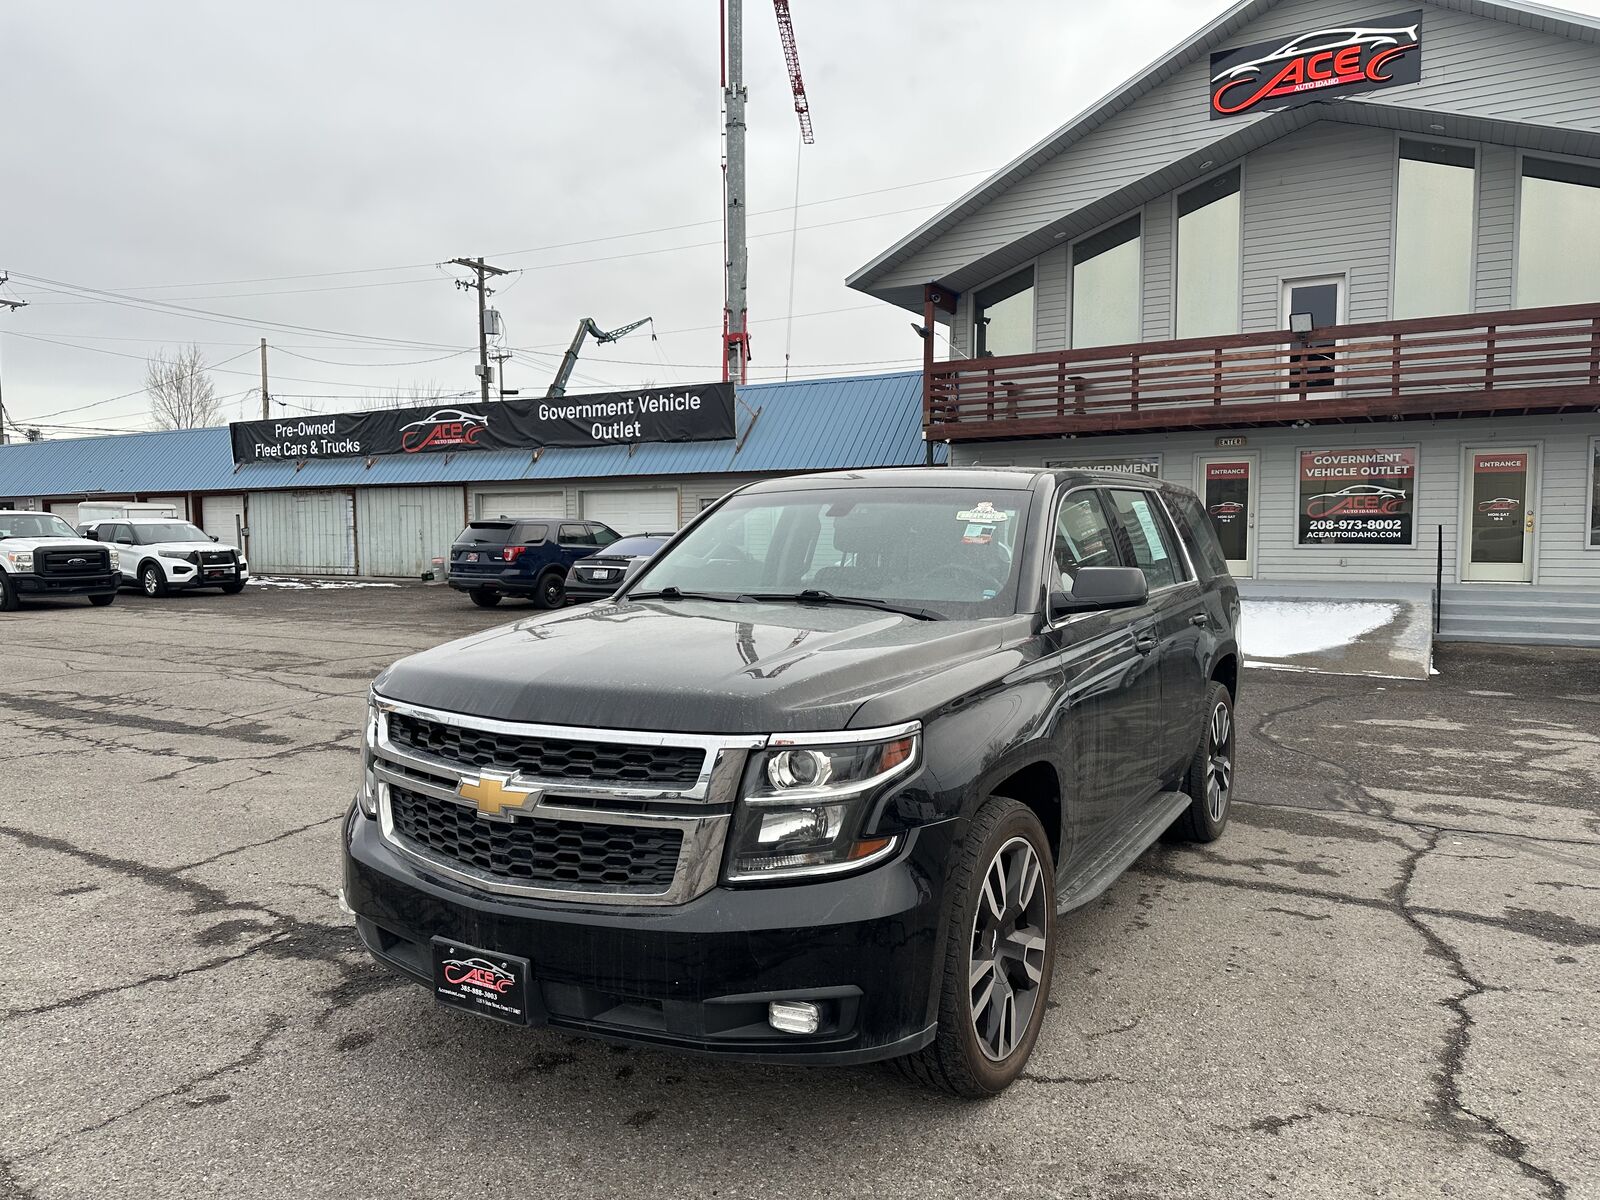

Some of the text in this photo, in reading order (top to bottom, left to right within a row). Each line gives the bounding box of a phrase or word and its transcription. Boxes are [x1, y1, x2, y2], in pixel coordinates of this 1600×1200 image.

[1294, 77, 1339, 92] AUTO IDAHO
[538, 392, 701, 421] Government Vehicle
[275, 419, 336, 438] Pre-Owned
[591, 420, 641, 440] Outlet
[255, 438, 361, 457] Fleet Cars & Trucks
[1220, 438, 1241, 446] ENTER
[1313, 453, 1402, 465] GOVERNMENT
[1480, 460, 1521, 468] ENTRANCE
[1071, 463, 1159, 473] VERNMENT
[1305, 465, 1410, 477] VEHICLE OUTLET
[1309, 519, 1402, 530] 208-973-8002
